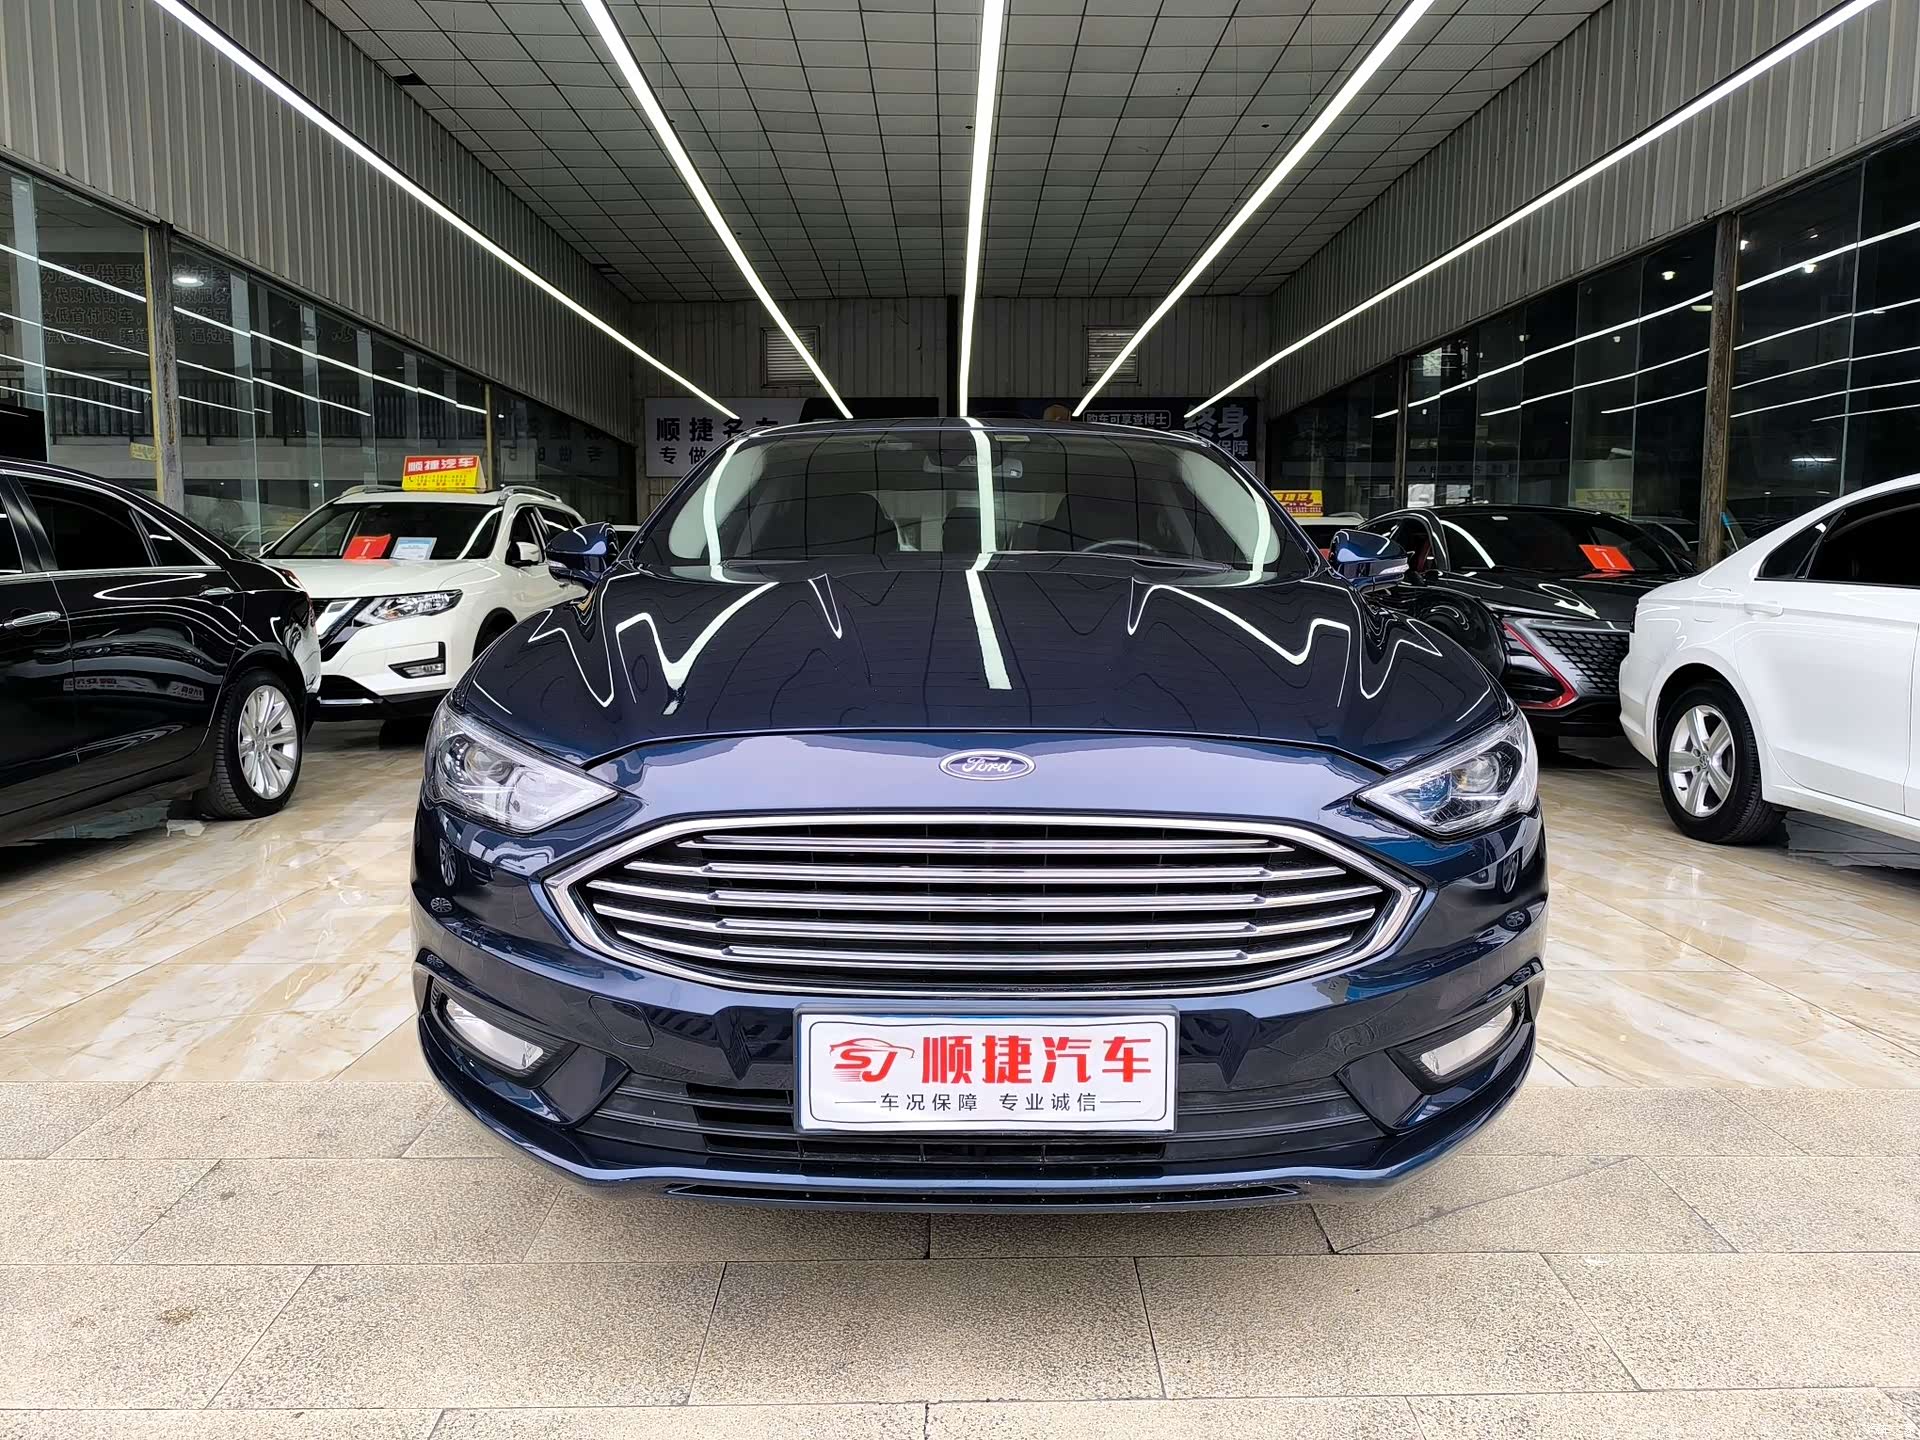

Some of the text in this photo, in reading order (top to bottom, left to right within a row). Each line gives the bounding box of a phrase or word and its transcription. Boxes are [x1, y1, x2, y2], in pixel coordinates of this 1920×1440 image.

[962, 756, 1013, 773] Ford
[922, 1035, 1152, 1084] 顺捷汽车
[880, 1093, 1097, 1112] 车况保障 专业诚信
